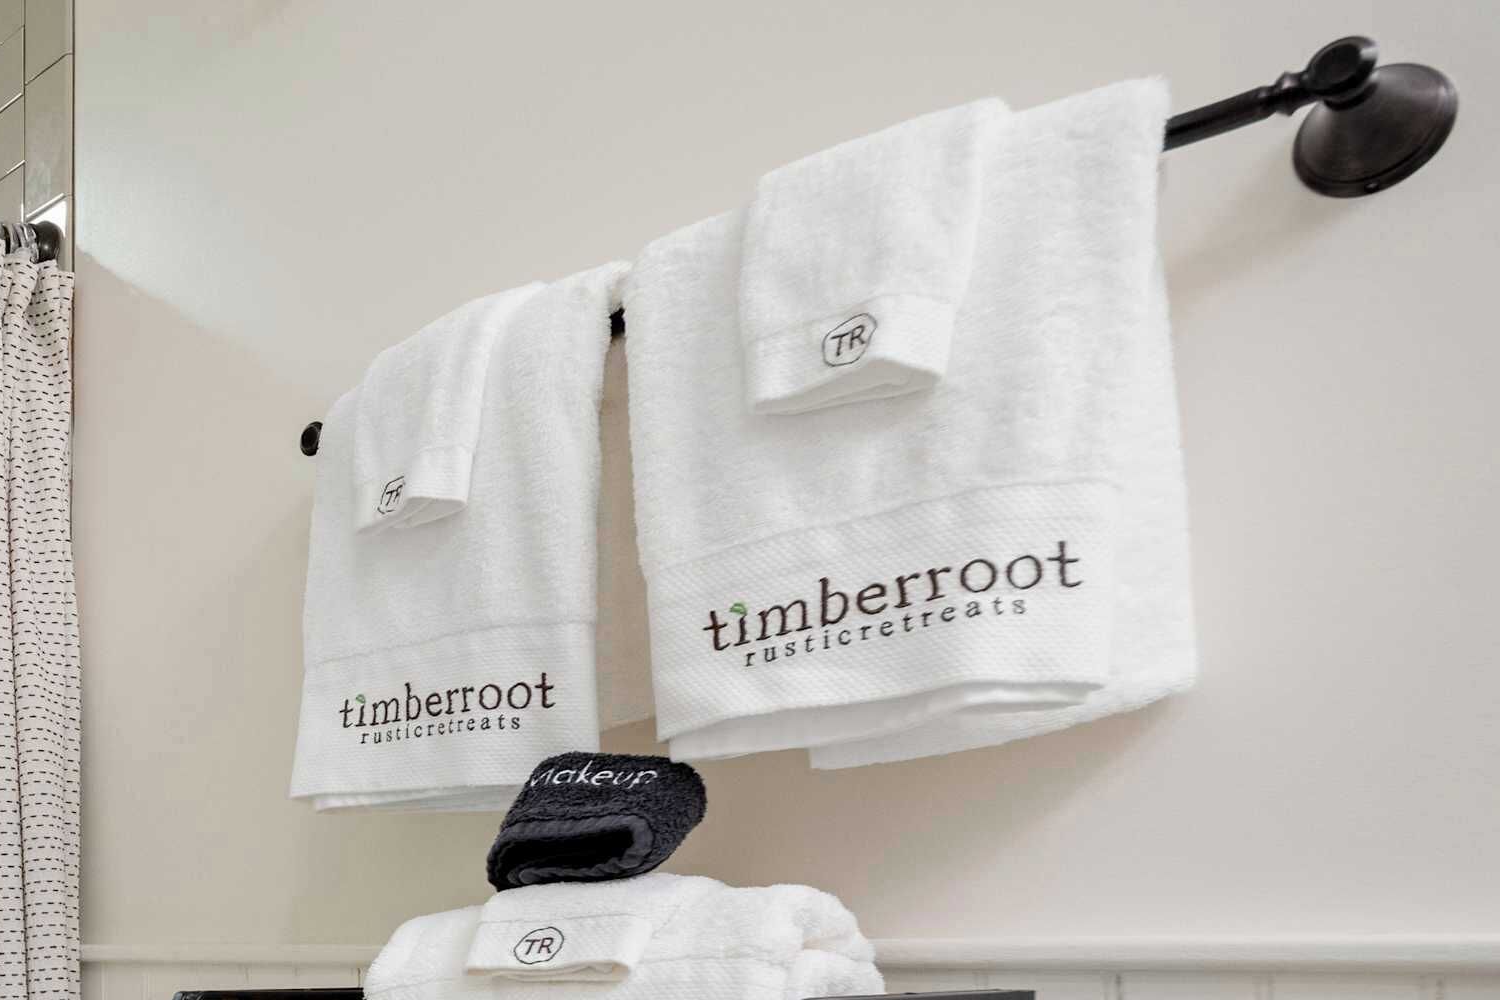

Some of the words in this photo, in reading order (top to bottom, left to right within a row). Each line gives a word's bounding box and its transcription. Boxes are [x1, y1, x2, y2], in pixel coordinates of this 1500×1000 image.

[831, 324, 868, 358] TR
[703, 541, 1083, 652] timberroot
[339, 672, 557, 729] timberroot
[360, 714, 521, 744] rusticretreats
[524, 936, 555, 955] TR
